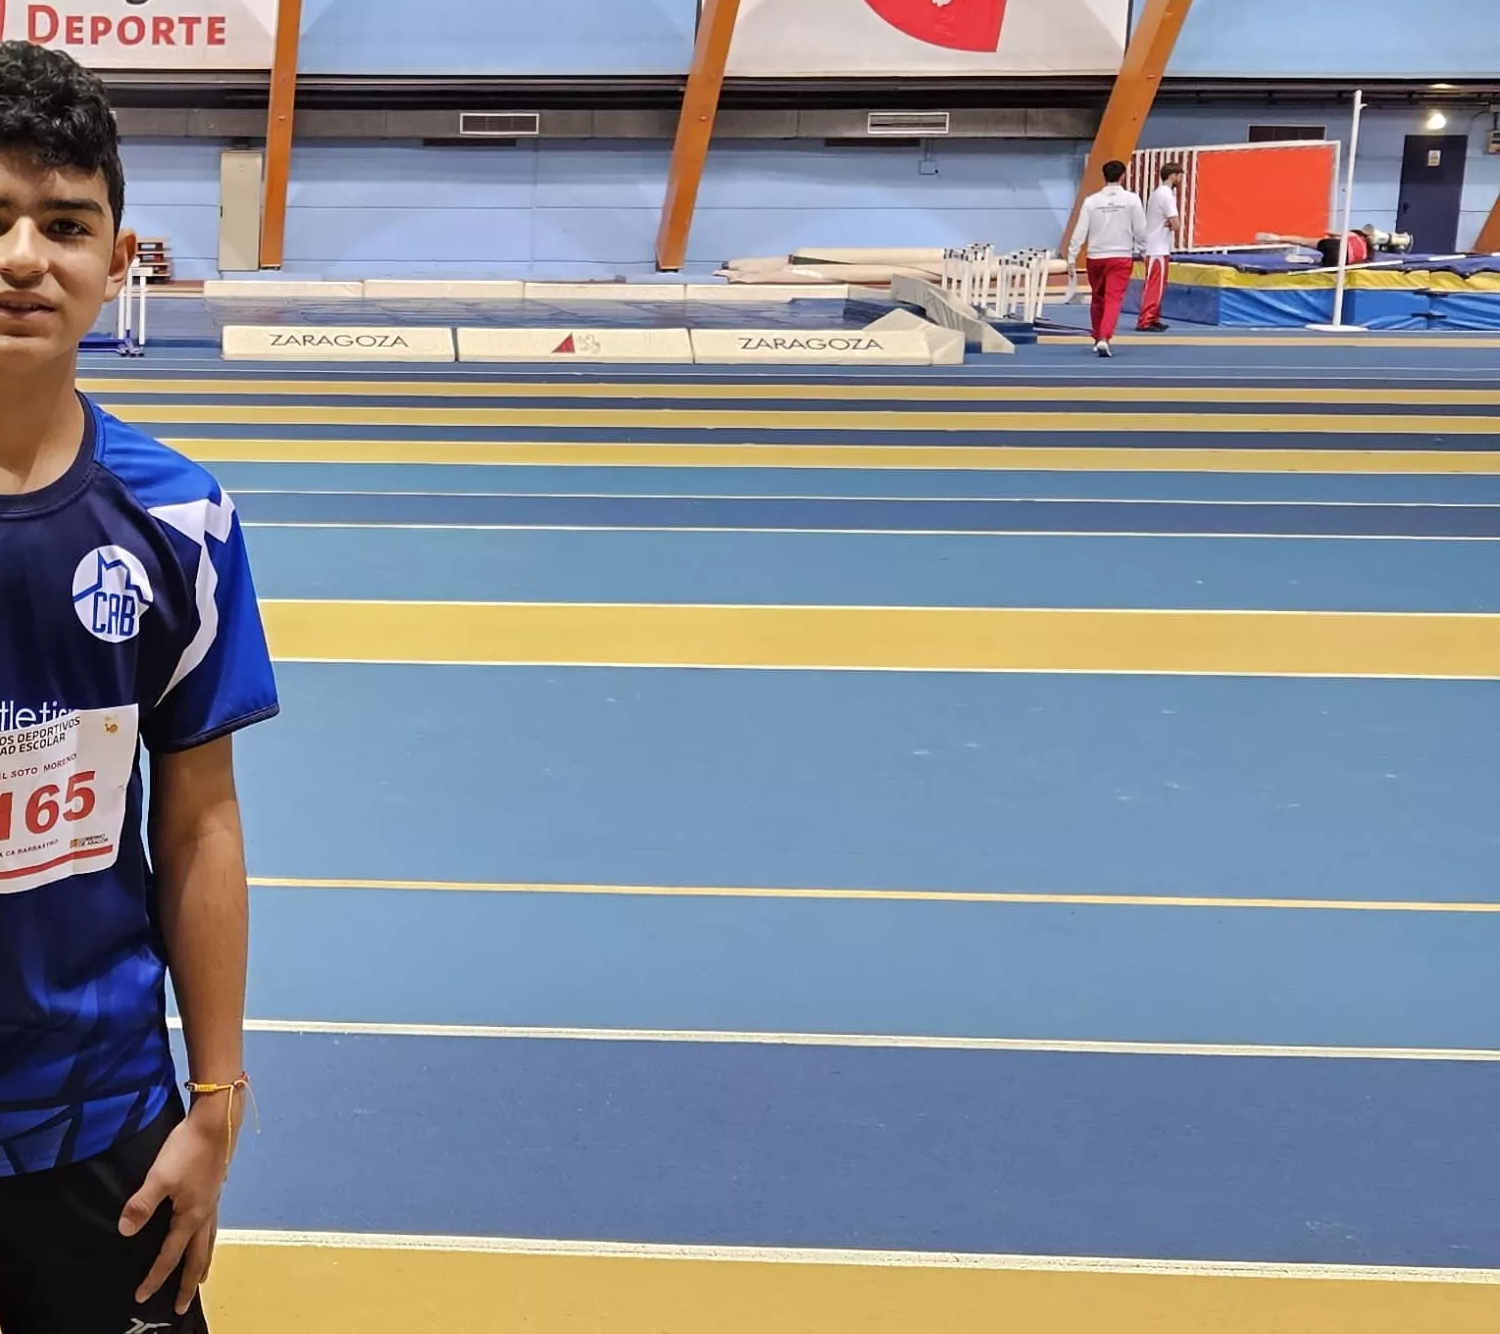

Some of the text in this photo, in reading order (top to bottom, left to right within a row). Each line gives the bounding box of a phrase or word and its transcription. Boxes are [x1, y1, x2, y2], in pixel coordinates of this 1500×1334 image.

[27, 4, 227, 46] DEPORTE
[269, 334, 409, 348] ZARAGOZA
[738, 337, 884, 350] ZARAGOZA
[92, 591, 135, 637] CAB
[17, 716, 81, 744] DEPORTIVOS
[19, 733, 66, 753] ESCOLAR
[11, 767, 38, 778] SOTO
